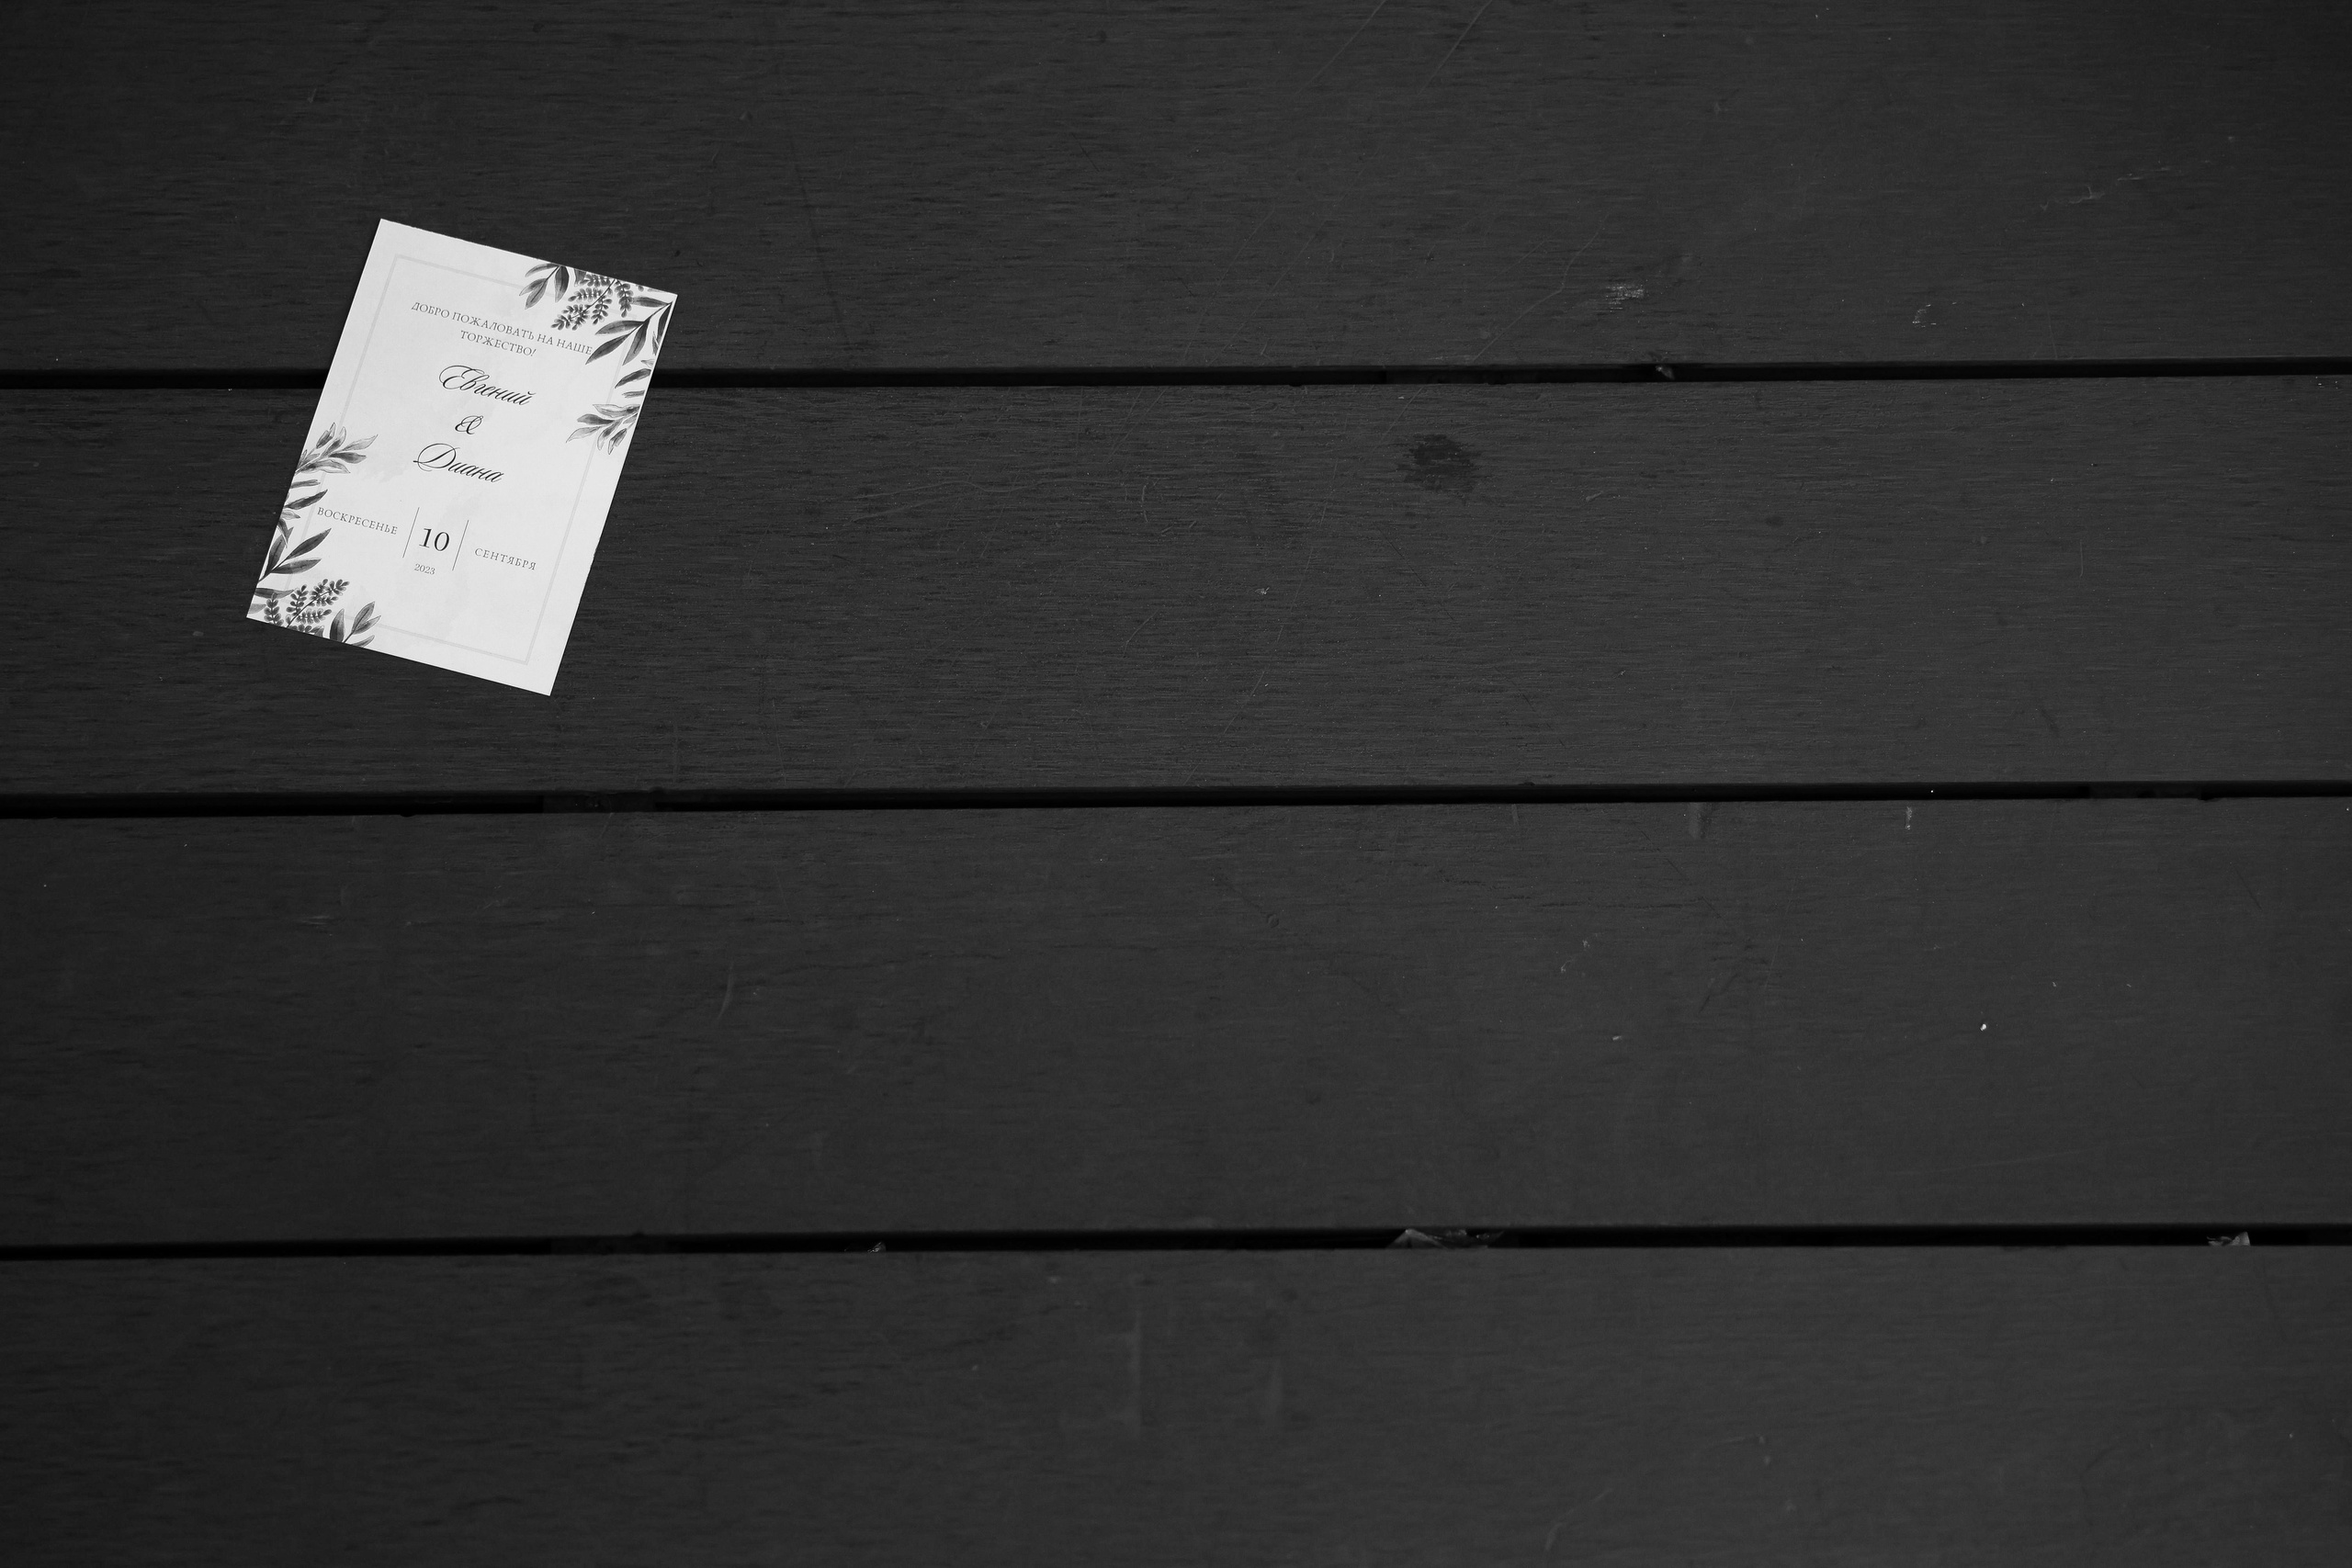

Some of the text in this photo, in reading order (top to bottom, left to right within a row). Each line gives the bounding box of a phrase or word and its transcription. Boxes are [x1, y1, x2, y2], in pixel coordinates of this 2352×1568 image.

[411, 301, 594, 355] ДОБРО ПОЖАЛОВАТЬ НА НАШЕ
[460, 330, 537, 357] ТОРЖЕСТВО!
[438, 365, 537, 405] Евгений
[413, 443, 504, 483] Диана
[317, 507, 398, 536] ВОСКРЕСЕНЬЕ
[419, 527, 450, 552] 10
[413, 563, 435, 576] 2023
[474, 547, 537, 571] СЕНТЯБРЯ
